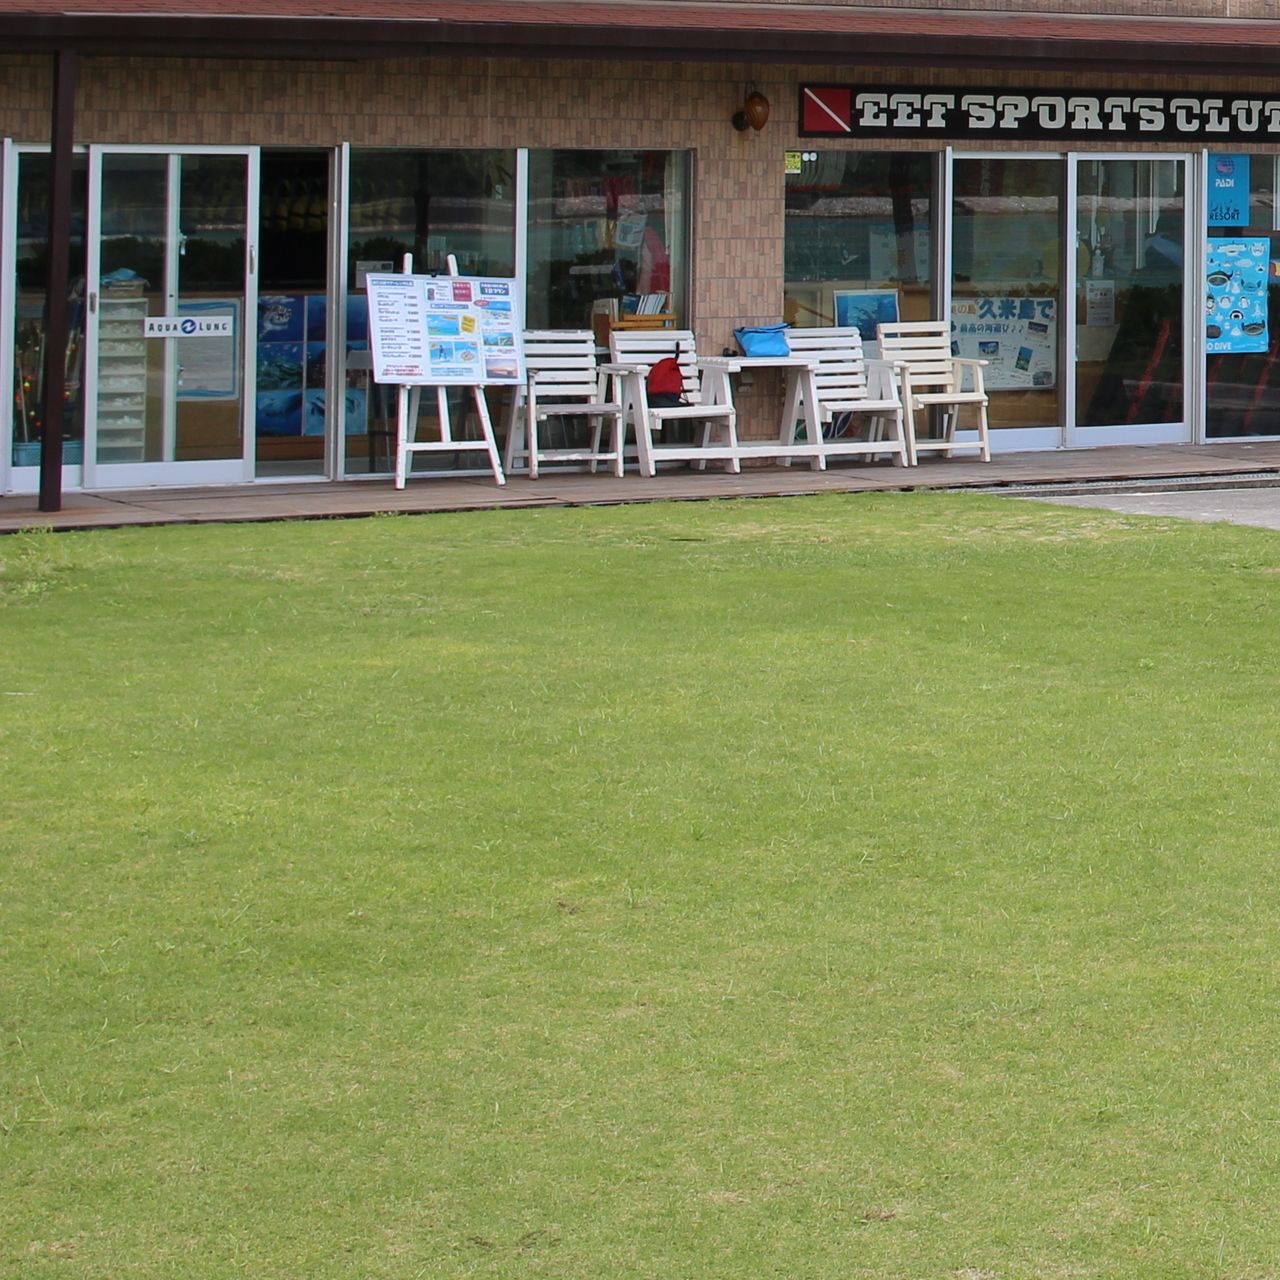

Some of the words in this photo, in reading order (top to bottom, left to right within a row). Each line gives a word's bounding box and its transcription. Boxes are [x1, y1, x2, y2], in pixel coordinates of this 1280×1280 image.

[855, 93, 956, 128] EEF
[961, 95, 1165, 132] SPORTS
[1215, 178, 1235, 188] PADI
[1209, 211, 1241, 221] RESORT
[978, 298, 1055, 320] 久米島で
[148, 323, 178, 332] AQUA
[199, 322, 228, 331] LUNG
[1214, 342, 1232, 350] DIVE
